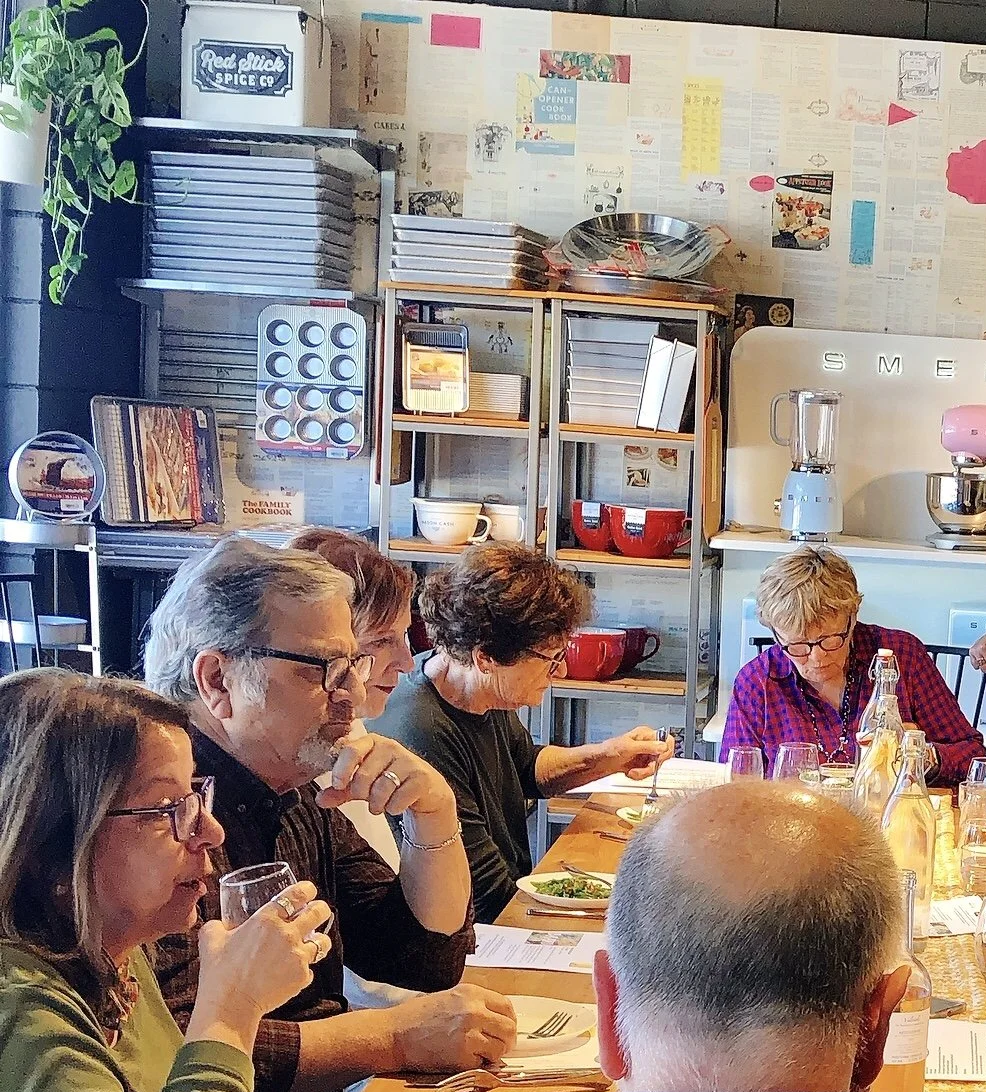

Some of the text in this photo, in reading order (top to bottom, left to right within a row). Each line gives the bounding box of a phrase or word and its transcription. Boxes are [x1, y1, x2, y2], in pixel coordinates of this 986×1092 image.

[200, 49, 286, 74] Red Stick
[215, 72, 256, 86] SPICE
[547, 86, 572, 94] CAN-
[538, 95, 575, 104] OPENER
[242, 507, 292, 516] COOKBOOK
